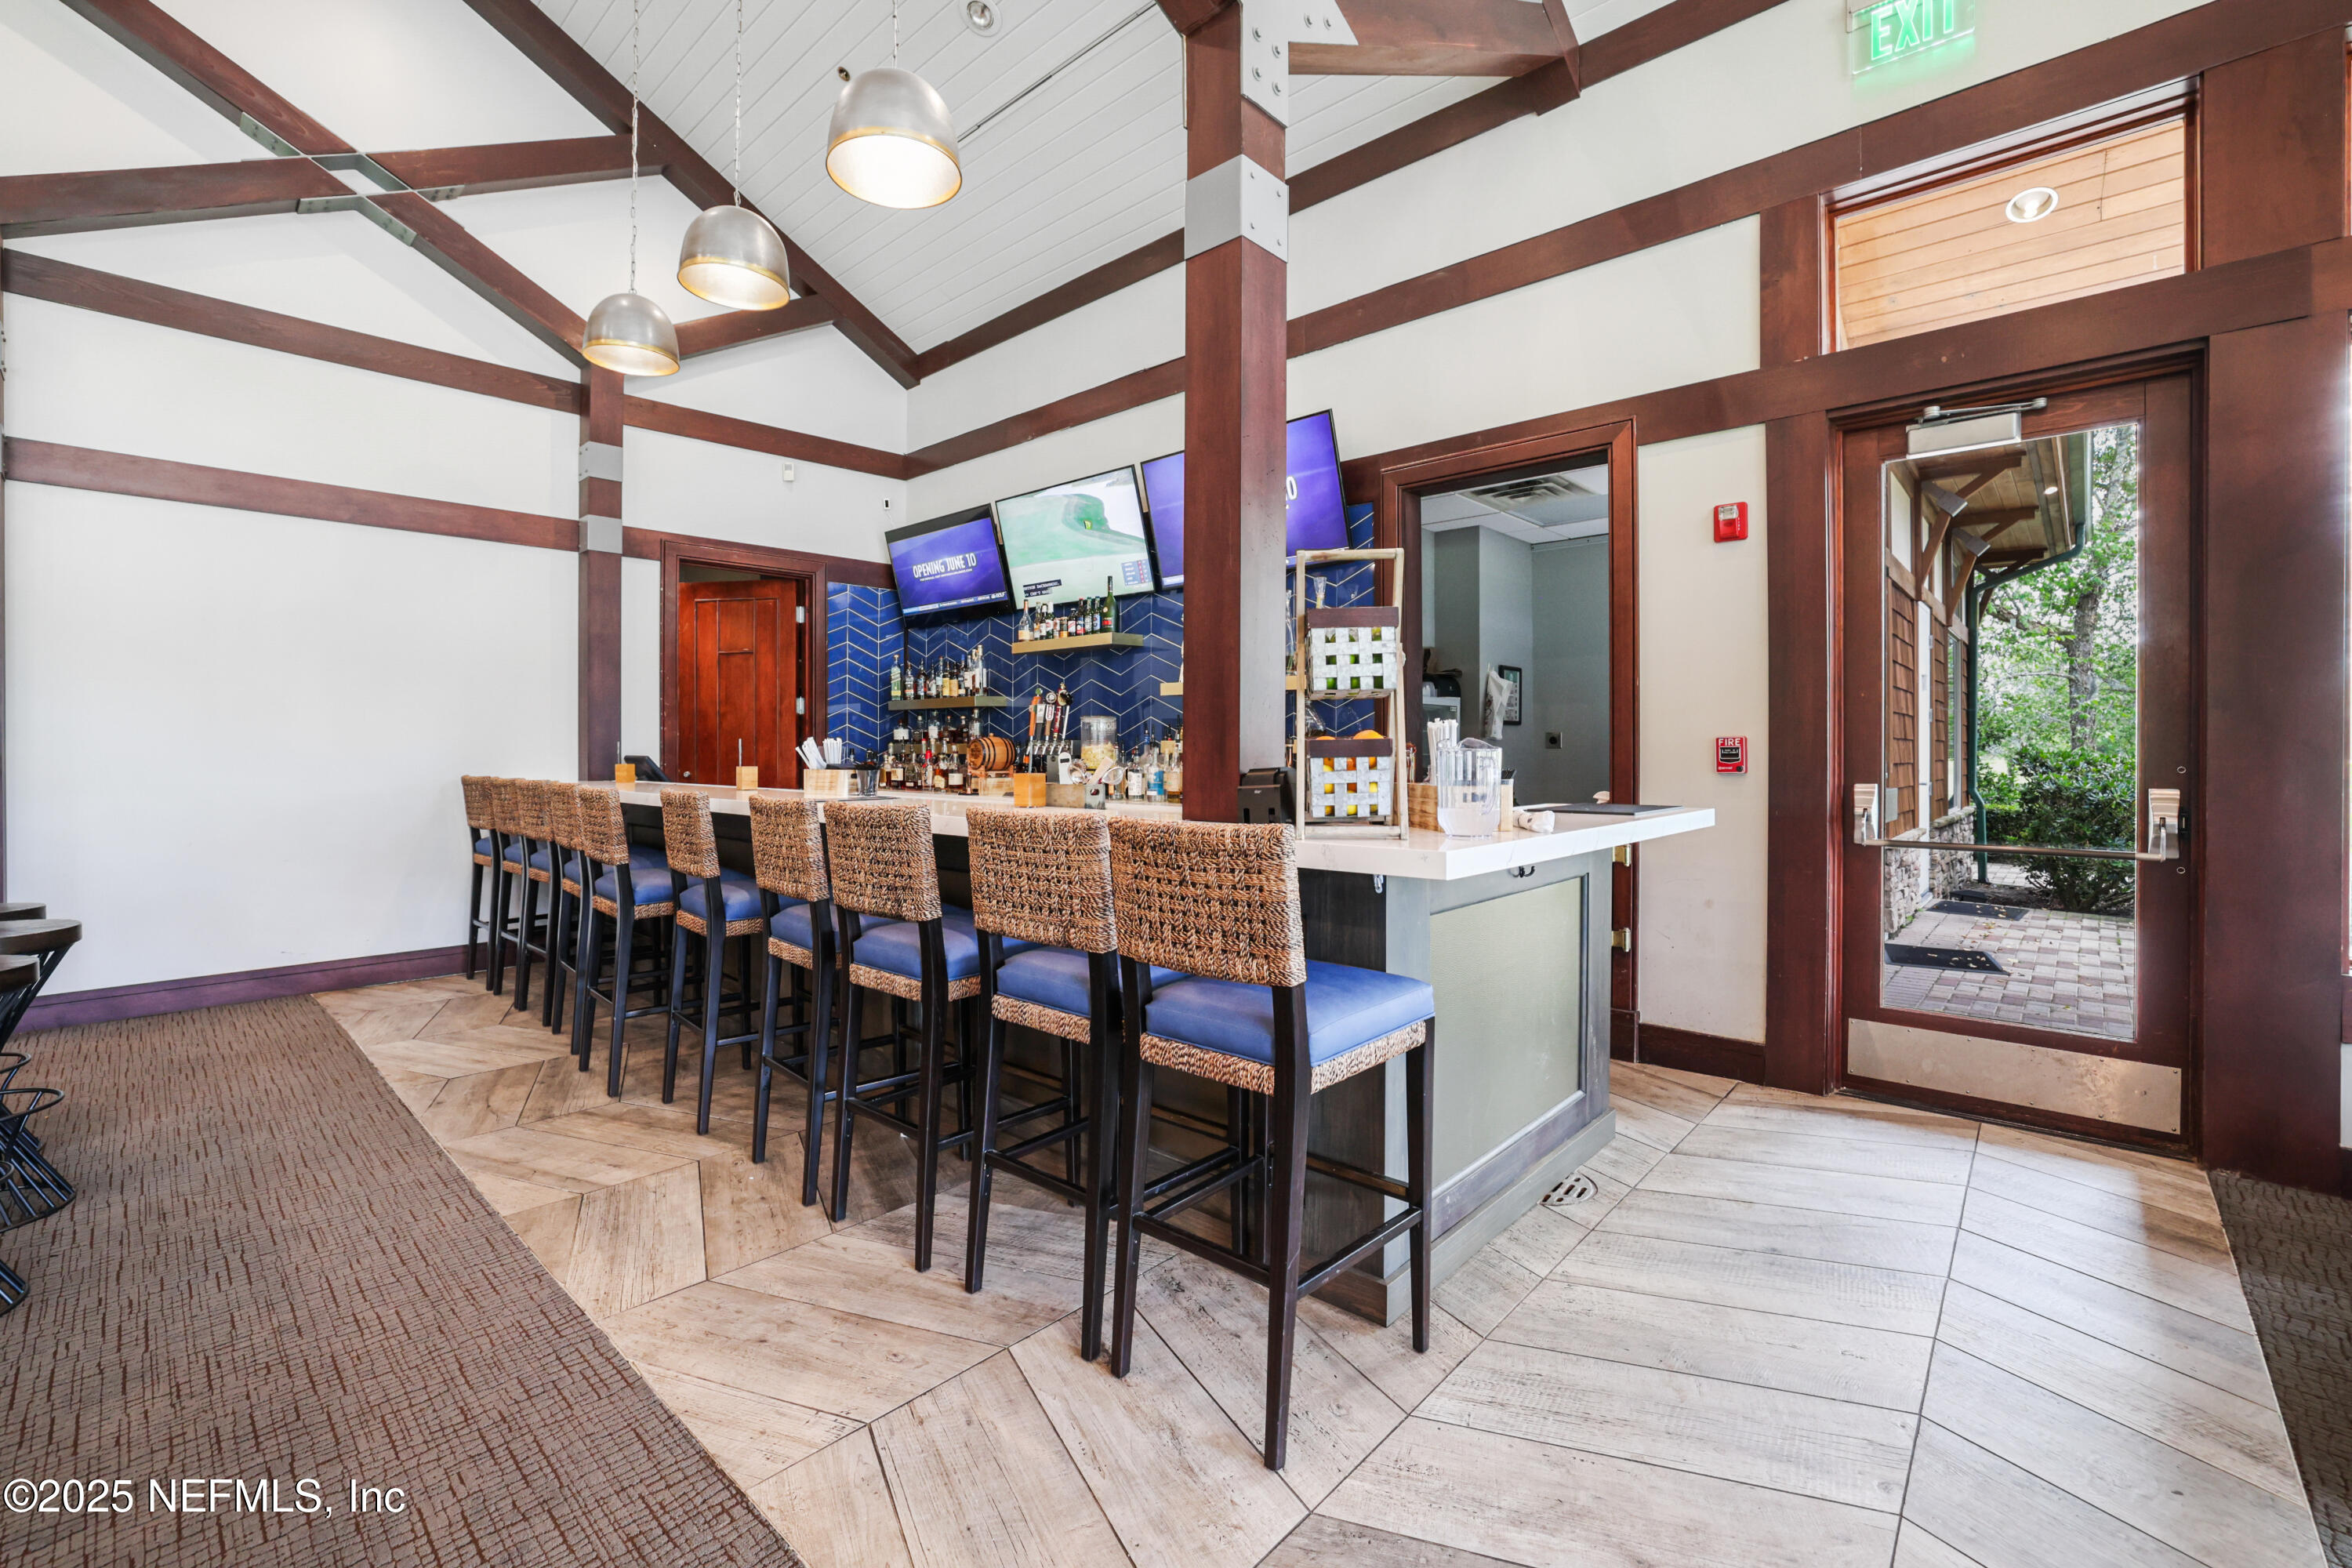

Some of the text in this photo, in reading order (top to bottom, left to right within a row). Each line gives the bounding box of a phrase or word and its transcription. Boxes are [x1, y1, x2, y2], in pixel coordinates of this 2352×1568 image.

[913, 560, 945, 579] OPENING
[946, 555, 966, 572] JUNE
[966, 552, 977, 568] 10
[1719, 738, 1741, 746] FIRE
